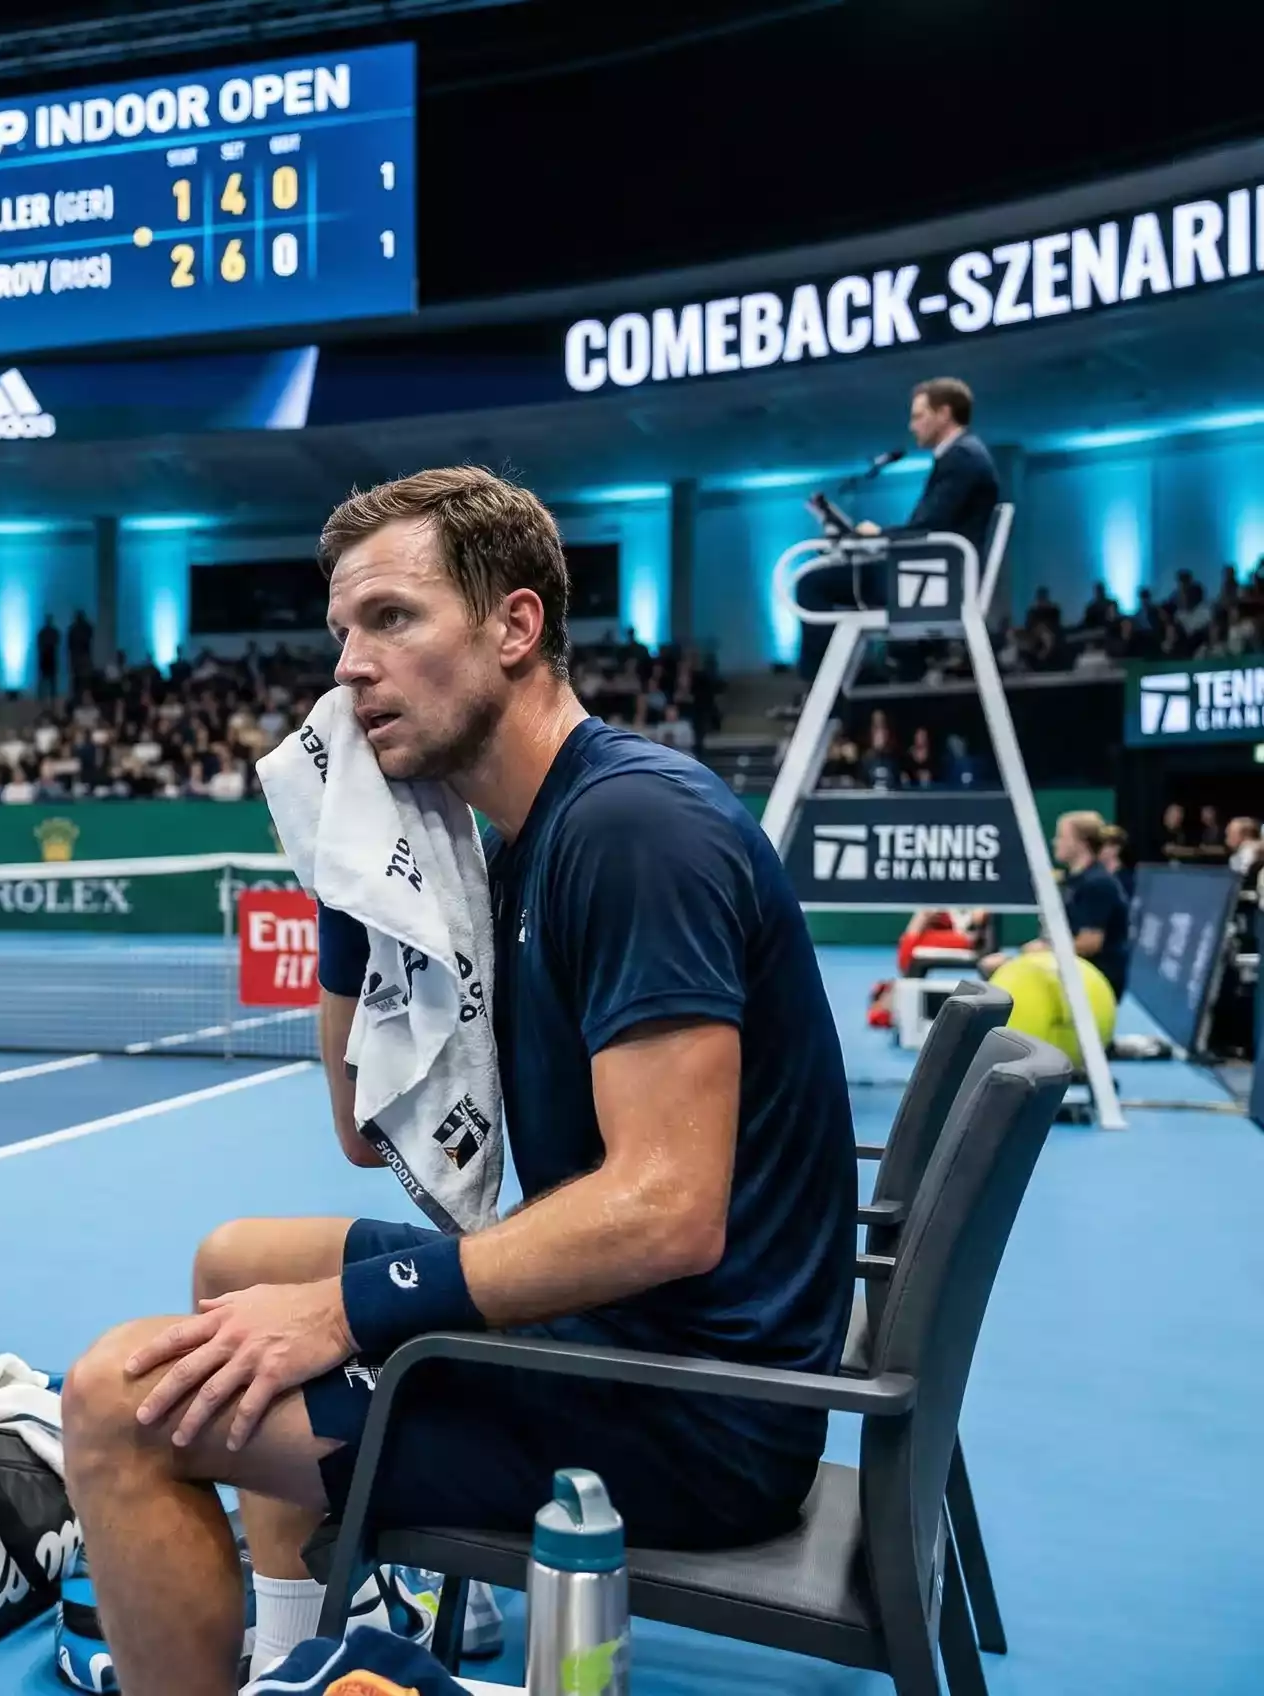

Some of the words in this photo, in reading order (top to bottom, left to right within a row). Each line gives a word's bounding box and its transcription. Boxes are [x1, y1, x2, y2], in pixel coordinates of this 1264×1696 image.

[36, 85, 210, 148] INDOOR
[219, 64, 351, 123] OPEN
[173, 179, 191, 222] 1
[220, 173, 246, 215] 4
[272, 165, 298, 209] 0
[380, 161, 395, 190] 1
[170, 243, 195, 288] 2
[220, 238, 246, 282] 6
[272, 232, 298, 277] 0
[380, 230, 395, 259] 1
[872, 824, 1000, 859] TENNIS
[874, 859, 1000, 881] CHANNEL
